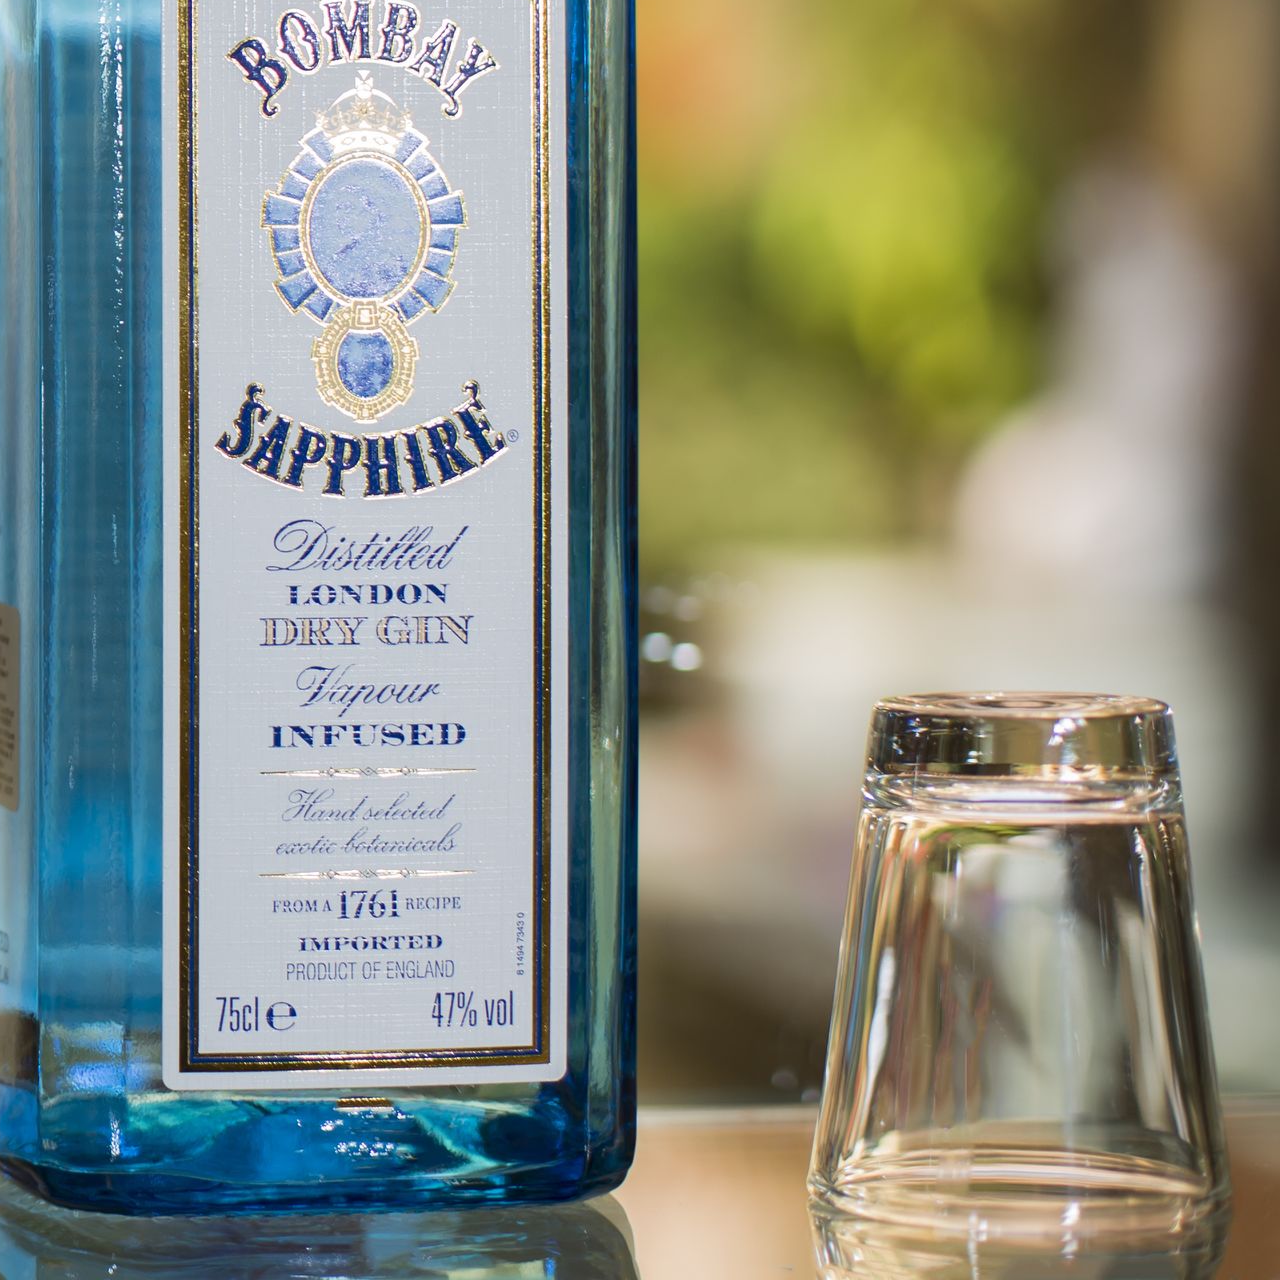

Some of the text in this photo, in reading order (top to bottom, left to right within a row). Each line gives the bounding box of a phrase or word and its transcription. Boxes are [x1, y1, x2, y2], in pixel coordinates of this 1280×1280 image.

[266, 519, 469, 572] Distilled
[286, 583, 450, 605] LONDON
[259, 615, 474, 646] DRY GIN
[295, 664, 440, 717] Vapour
[268, 723, 466, 748] INFUSED
[281, 788, 455, 822] Hand selected
[276, 823, 463, 855] exotic botanicals
[272, 890, 462, 920] FROM A 1761 RECIPE
[298, 934, 443, 952] IMPORTED
[286, 959, 455, 981] PRODUCT OF ENGLAND
[216, 996, 259, 1032] 75cl
[431, 990, 514, 1028] 47% vol
